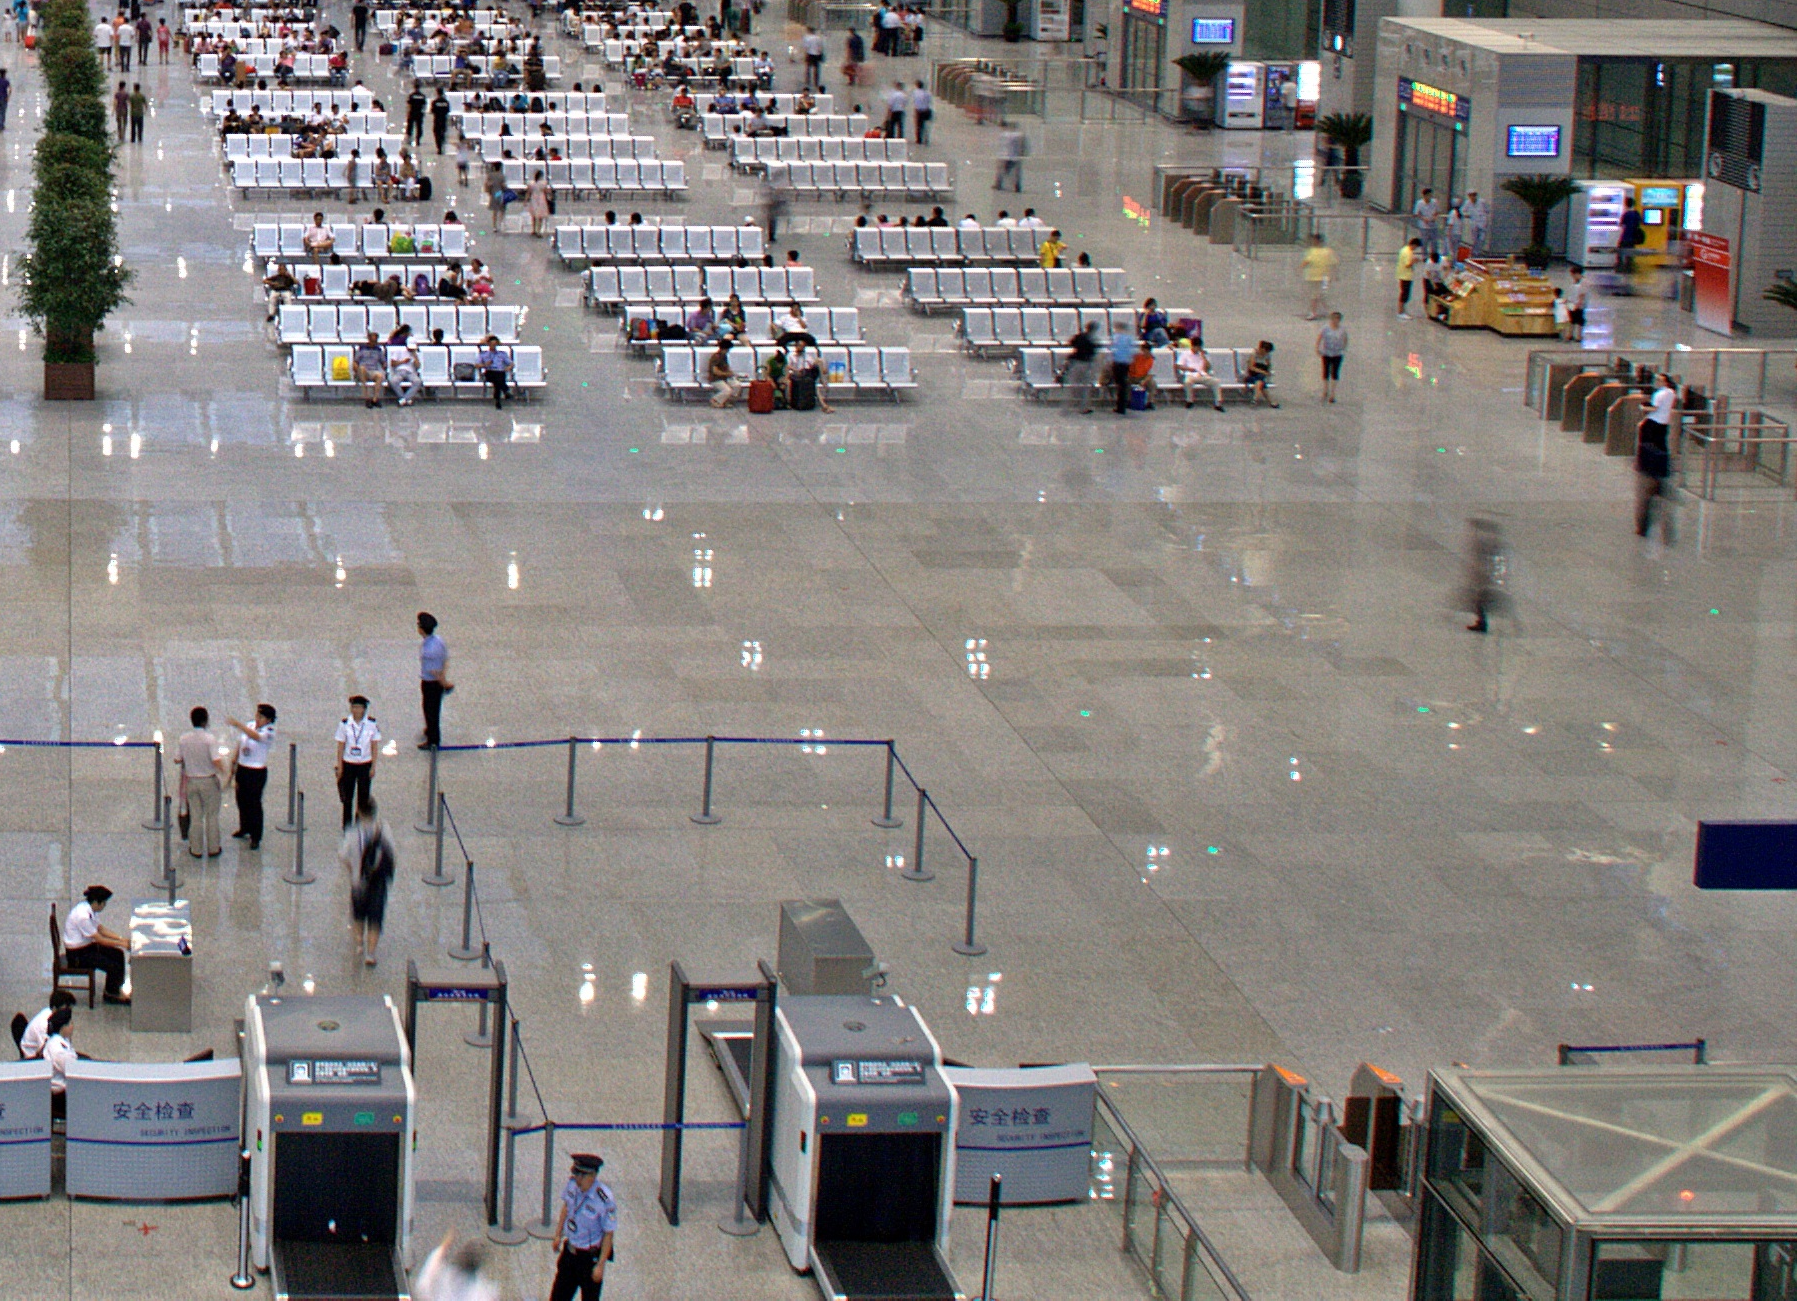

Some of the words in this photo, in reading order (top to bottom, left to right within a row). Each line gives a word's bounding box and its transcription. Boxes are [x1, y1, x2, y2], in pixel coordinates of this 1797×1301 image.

[113, 1101, 195, 1120] 安全检查
[969, 1107, 1050, 1126] 安全检查
[140, 1127, 180, 1137] SECURITY
[184, 1125, 231, 1136] INSPECTION
